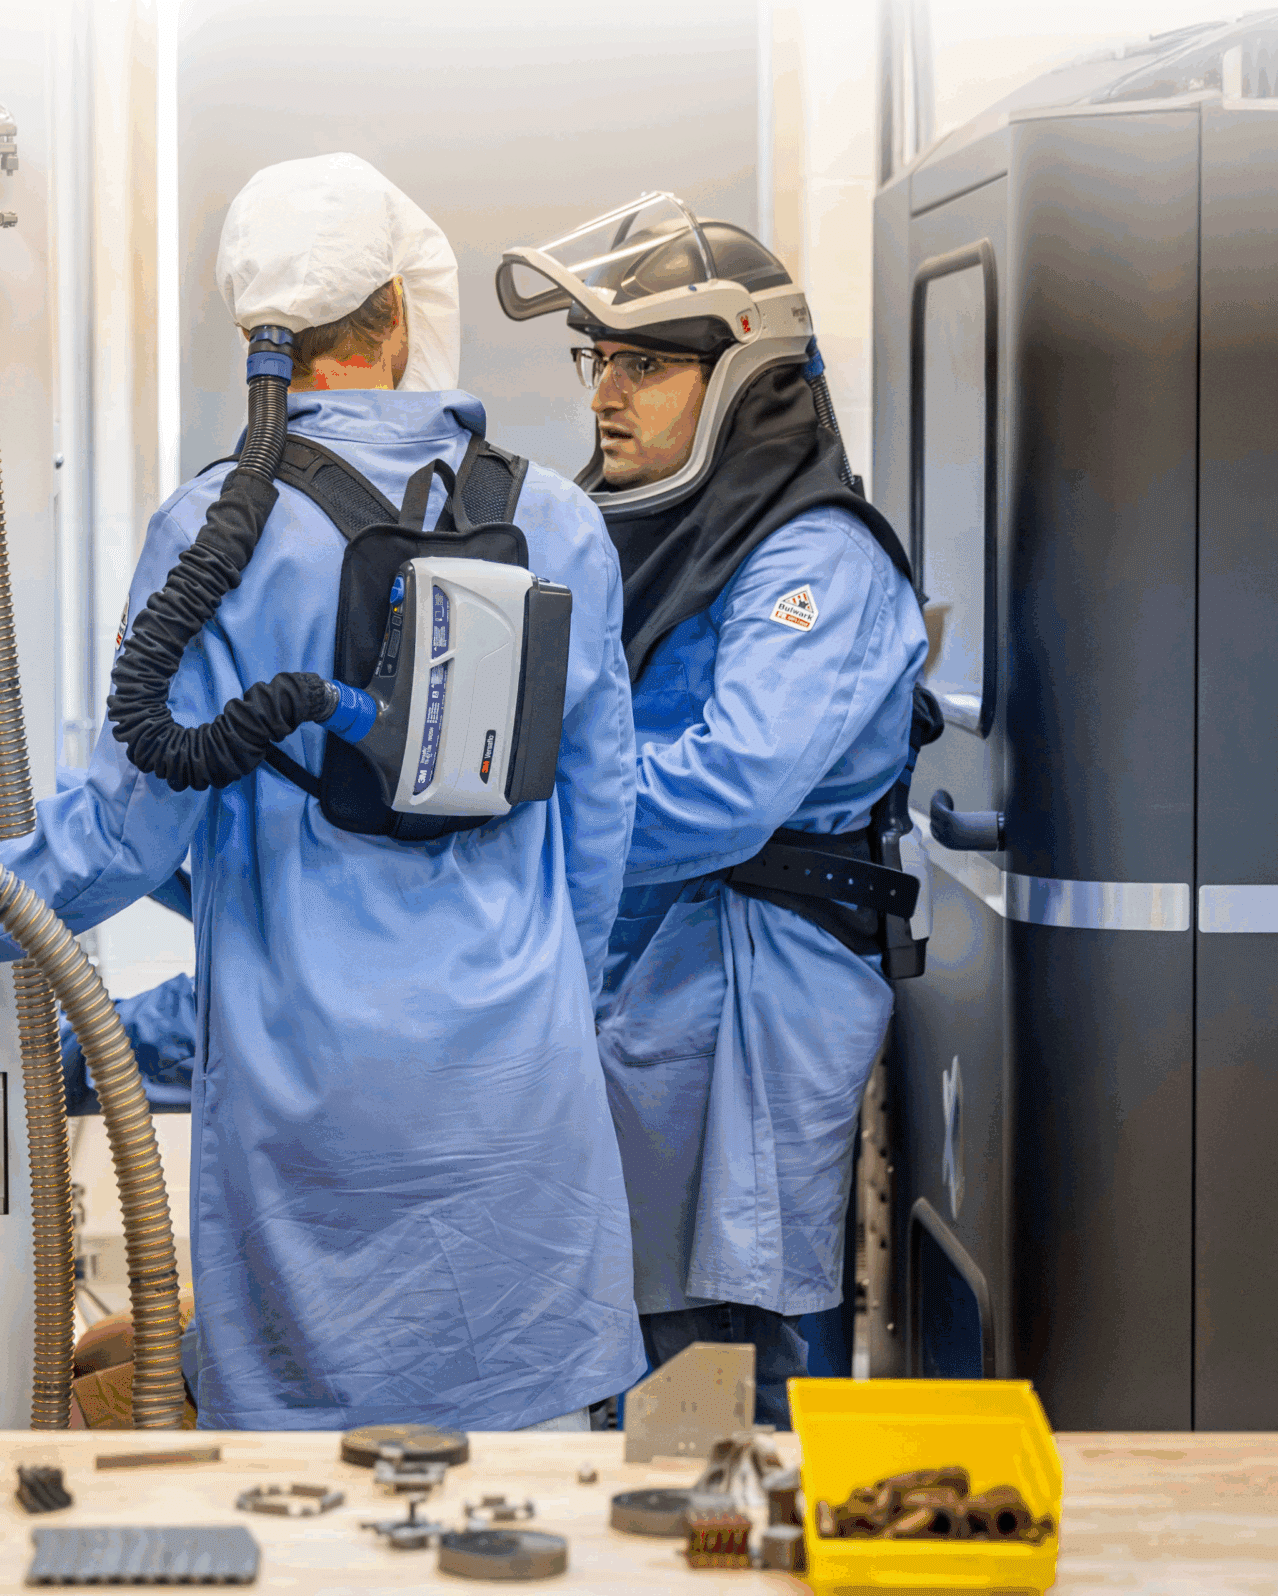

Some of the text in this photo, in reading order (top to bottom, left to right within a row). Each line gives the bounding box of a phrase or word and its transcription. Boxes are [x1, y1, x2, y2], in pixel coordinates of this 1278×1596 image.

[778, 603, 813, 622] Bulwark
[484, 734, 494, 759] Versaflo
[417, 769, 428, 784] 3M
